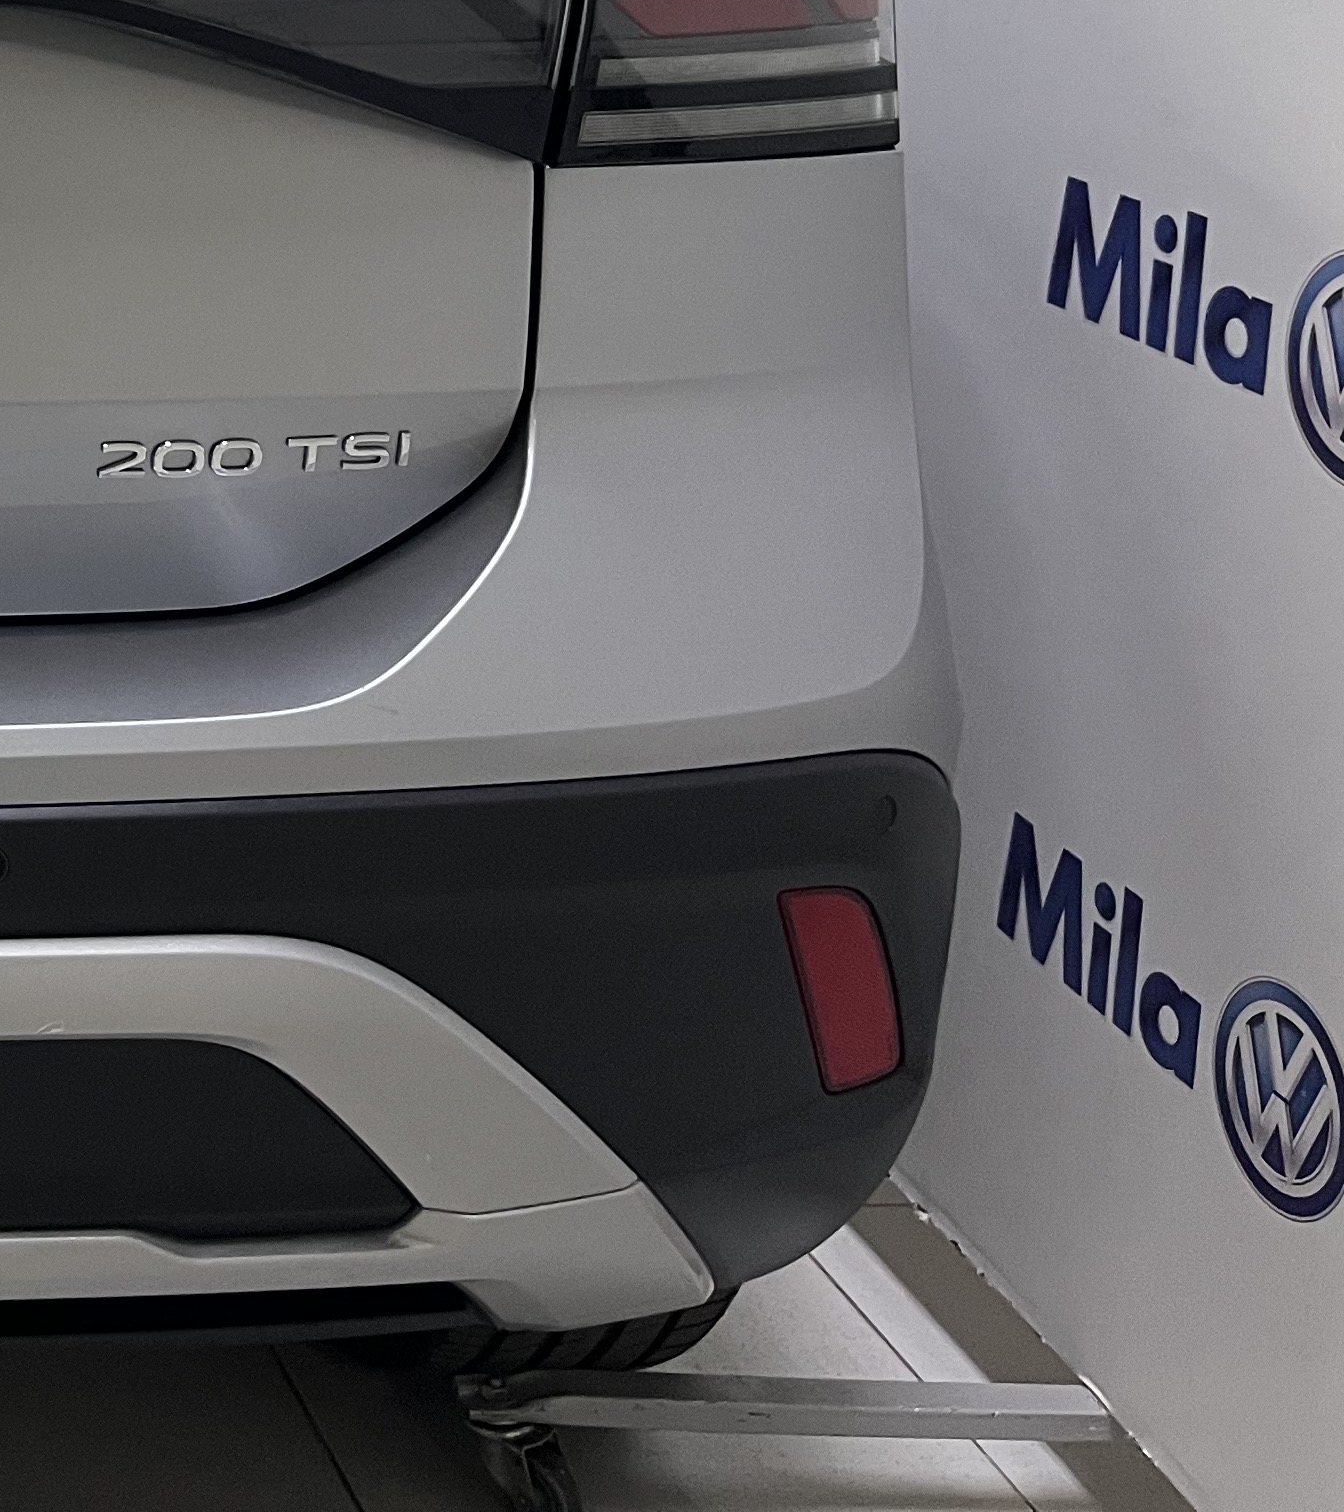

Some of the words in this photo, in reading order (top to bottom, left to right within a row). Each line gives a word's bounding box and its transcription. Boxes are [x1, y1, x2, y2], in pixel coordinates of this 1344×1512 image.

[1047, 175, 1274, 396] Mila
[97, 437, 263, 479] 200
[286, 430, 412, 473] TSI
[996, 811, 1202, 1090] Mila
